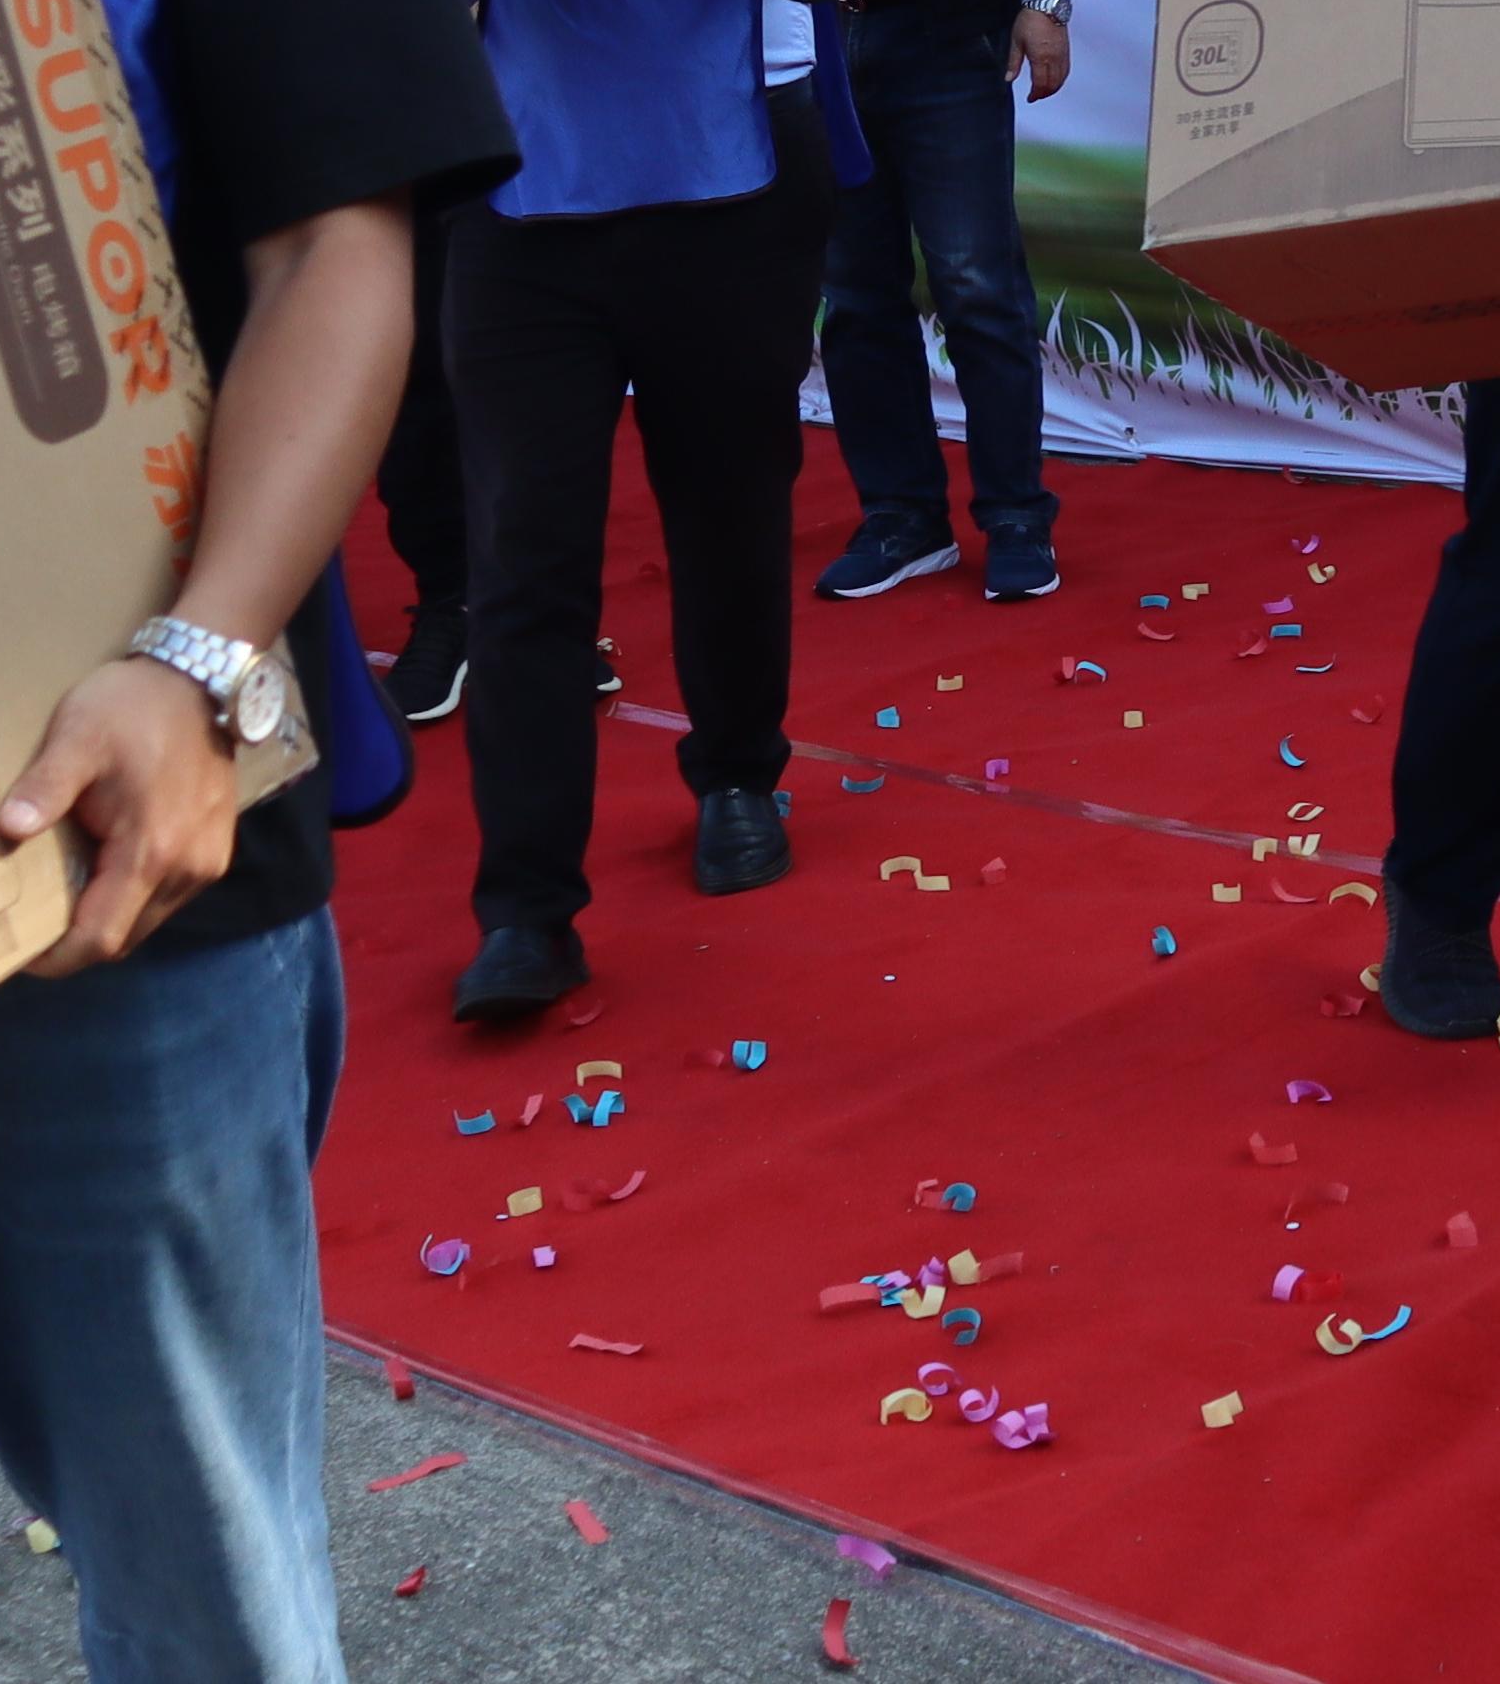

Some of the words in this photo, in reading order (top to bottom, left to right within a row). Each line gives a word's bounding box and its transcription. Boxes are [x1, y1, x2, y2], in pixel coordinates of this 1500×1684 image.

[1190, 44, 1227, 68] 30L
[31, 262, 82, 381] 电烤箱
[143, 429, 194, 578] 苏
